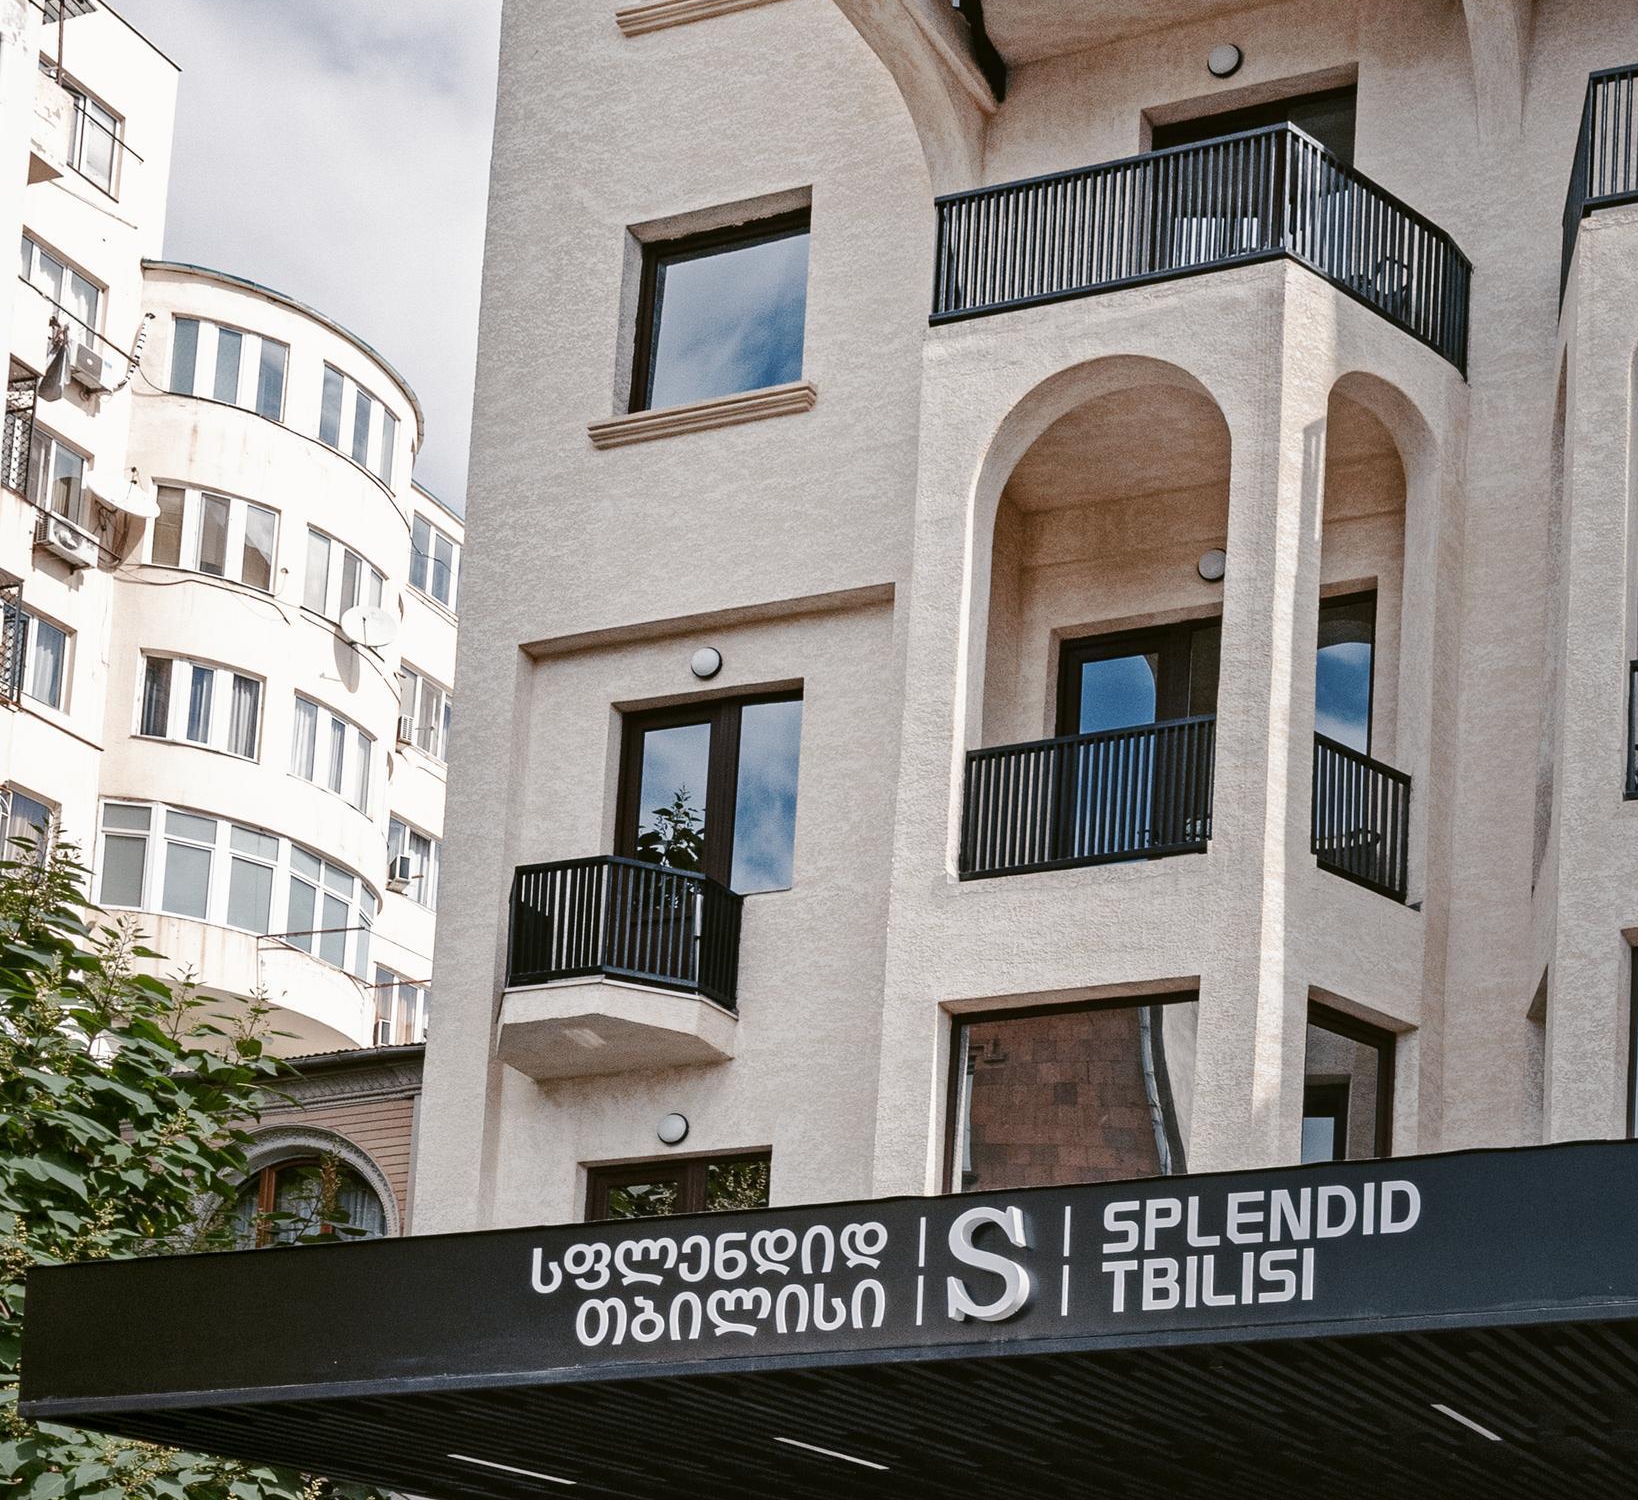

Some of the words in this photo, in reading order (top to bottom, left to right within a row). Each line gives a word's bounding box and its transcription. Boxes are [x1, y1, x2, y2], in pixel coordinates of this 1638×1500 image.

[1102, 1179, 1422, 1254] SPLENDID
[531, 1221, 889, 1294] სფლენდიდ
[946, 1205, 1031, 1322] S
[1101, 1247, 1315, 1313] TBILISI
[575, 1278, 887, 1347] თბილისი
